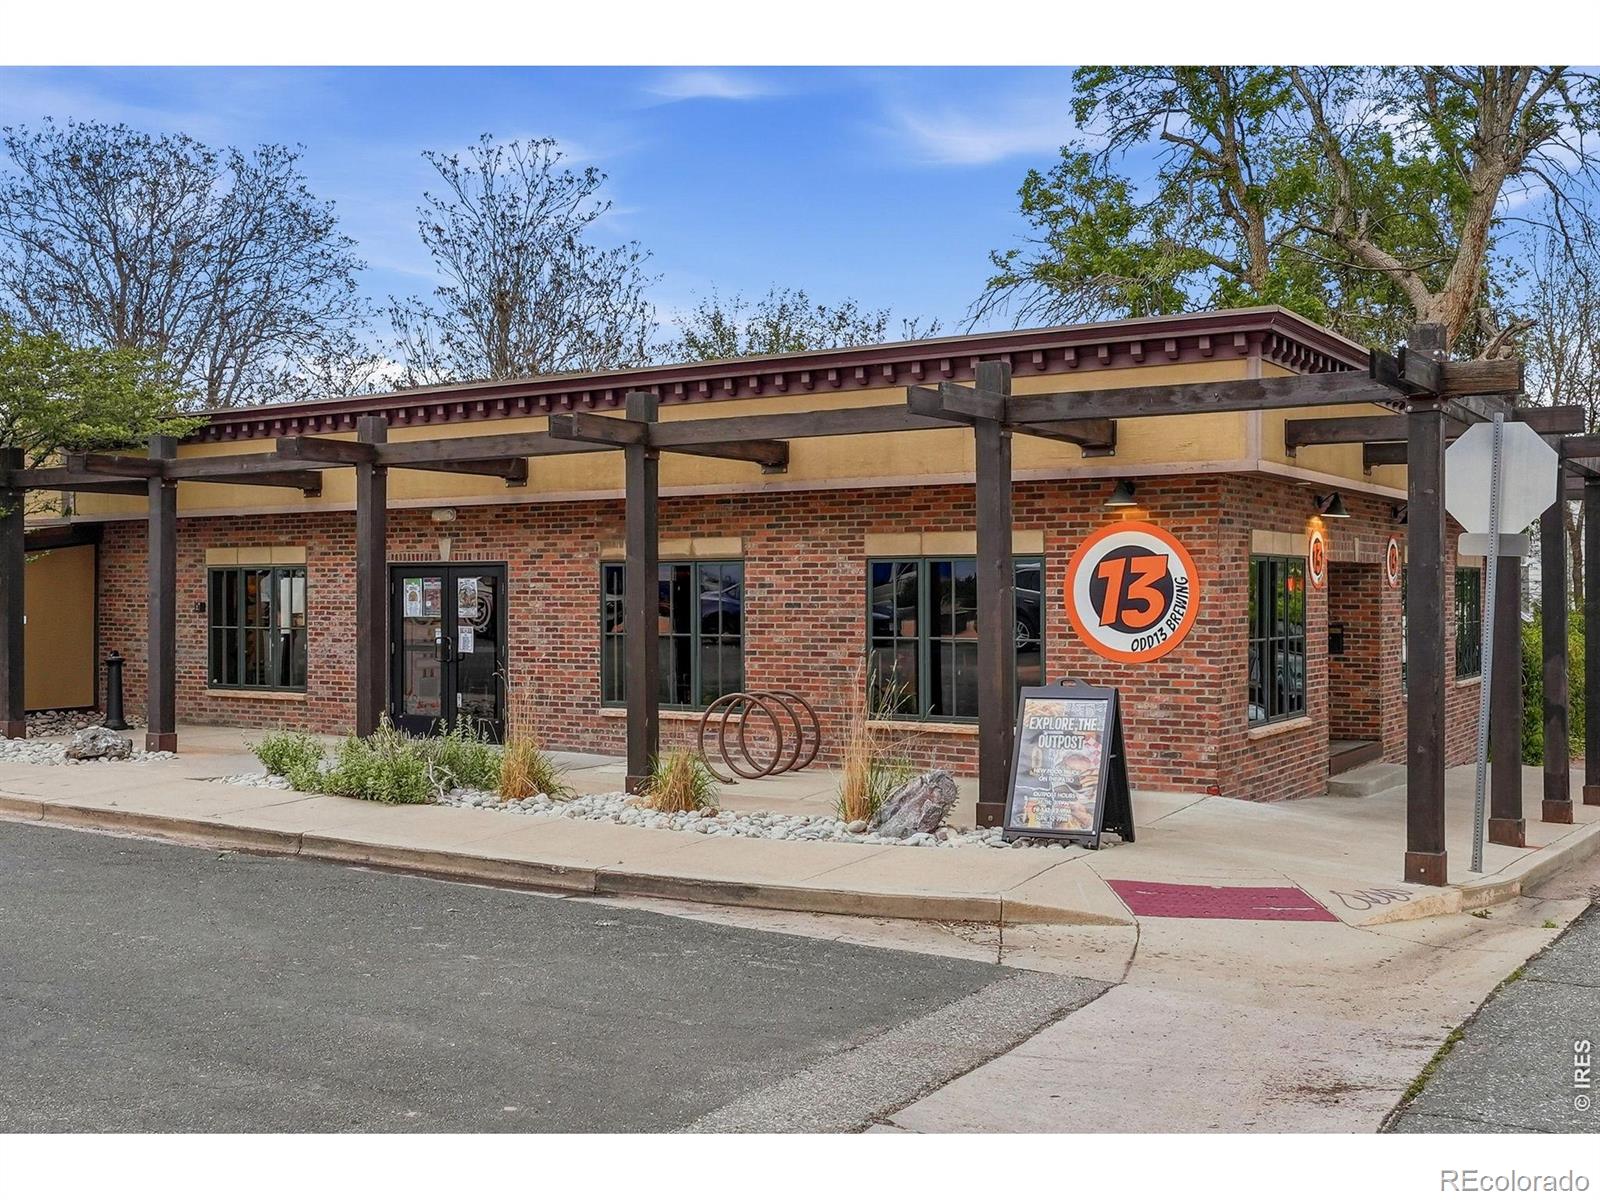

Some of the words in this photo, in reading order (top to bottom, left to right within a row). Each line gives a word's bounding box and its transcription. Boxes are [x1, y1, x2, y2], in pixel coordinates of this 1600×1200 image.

[1098, 554, 1168, 628] 13
[1131, 627, 1168, 652] ODD13
[1166, 576, 1189, 632] BREWING
[1029, 717, 1075, 731] EXPLORE
[1079, 717, 1098, 731] THE
[1038, 735, 1085, 749] OUTPOST
